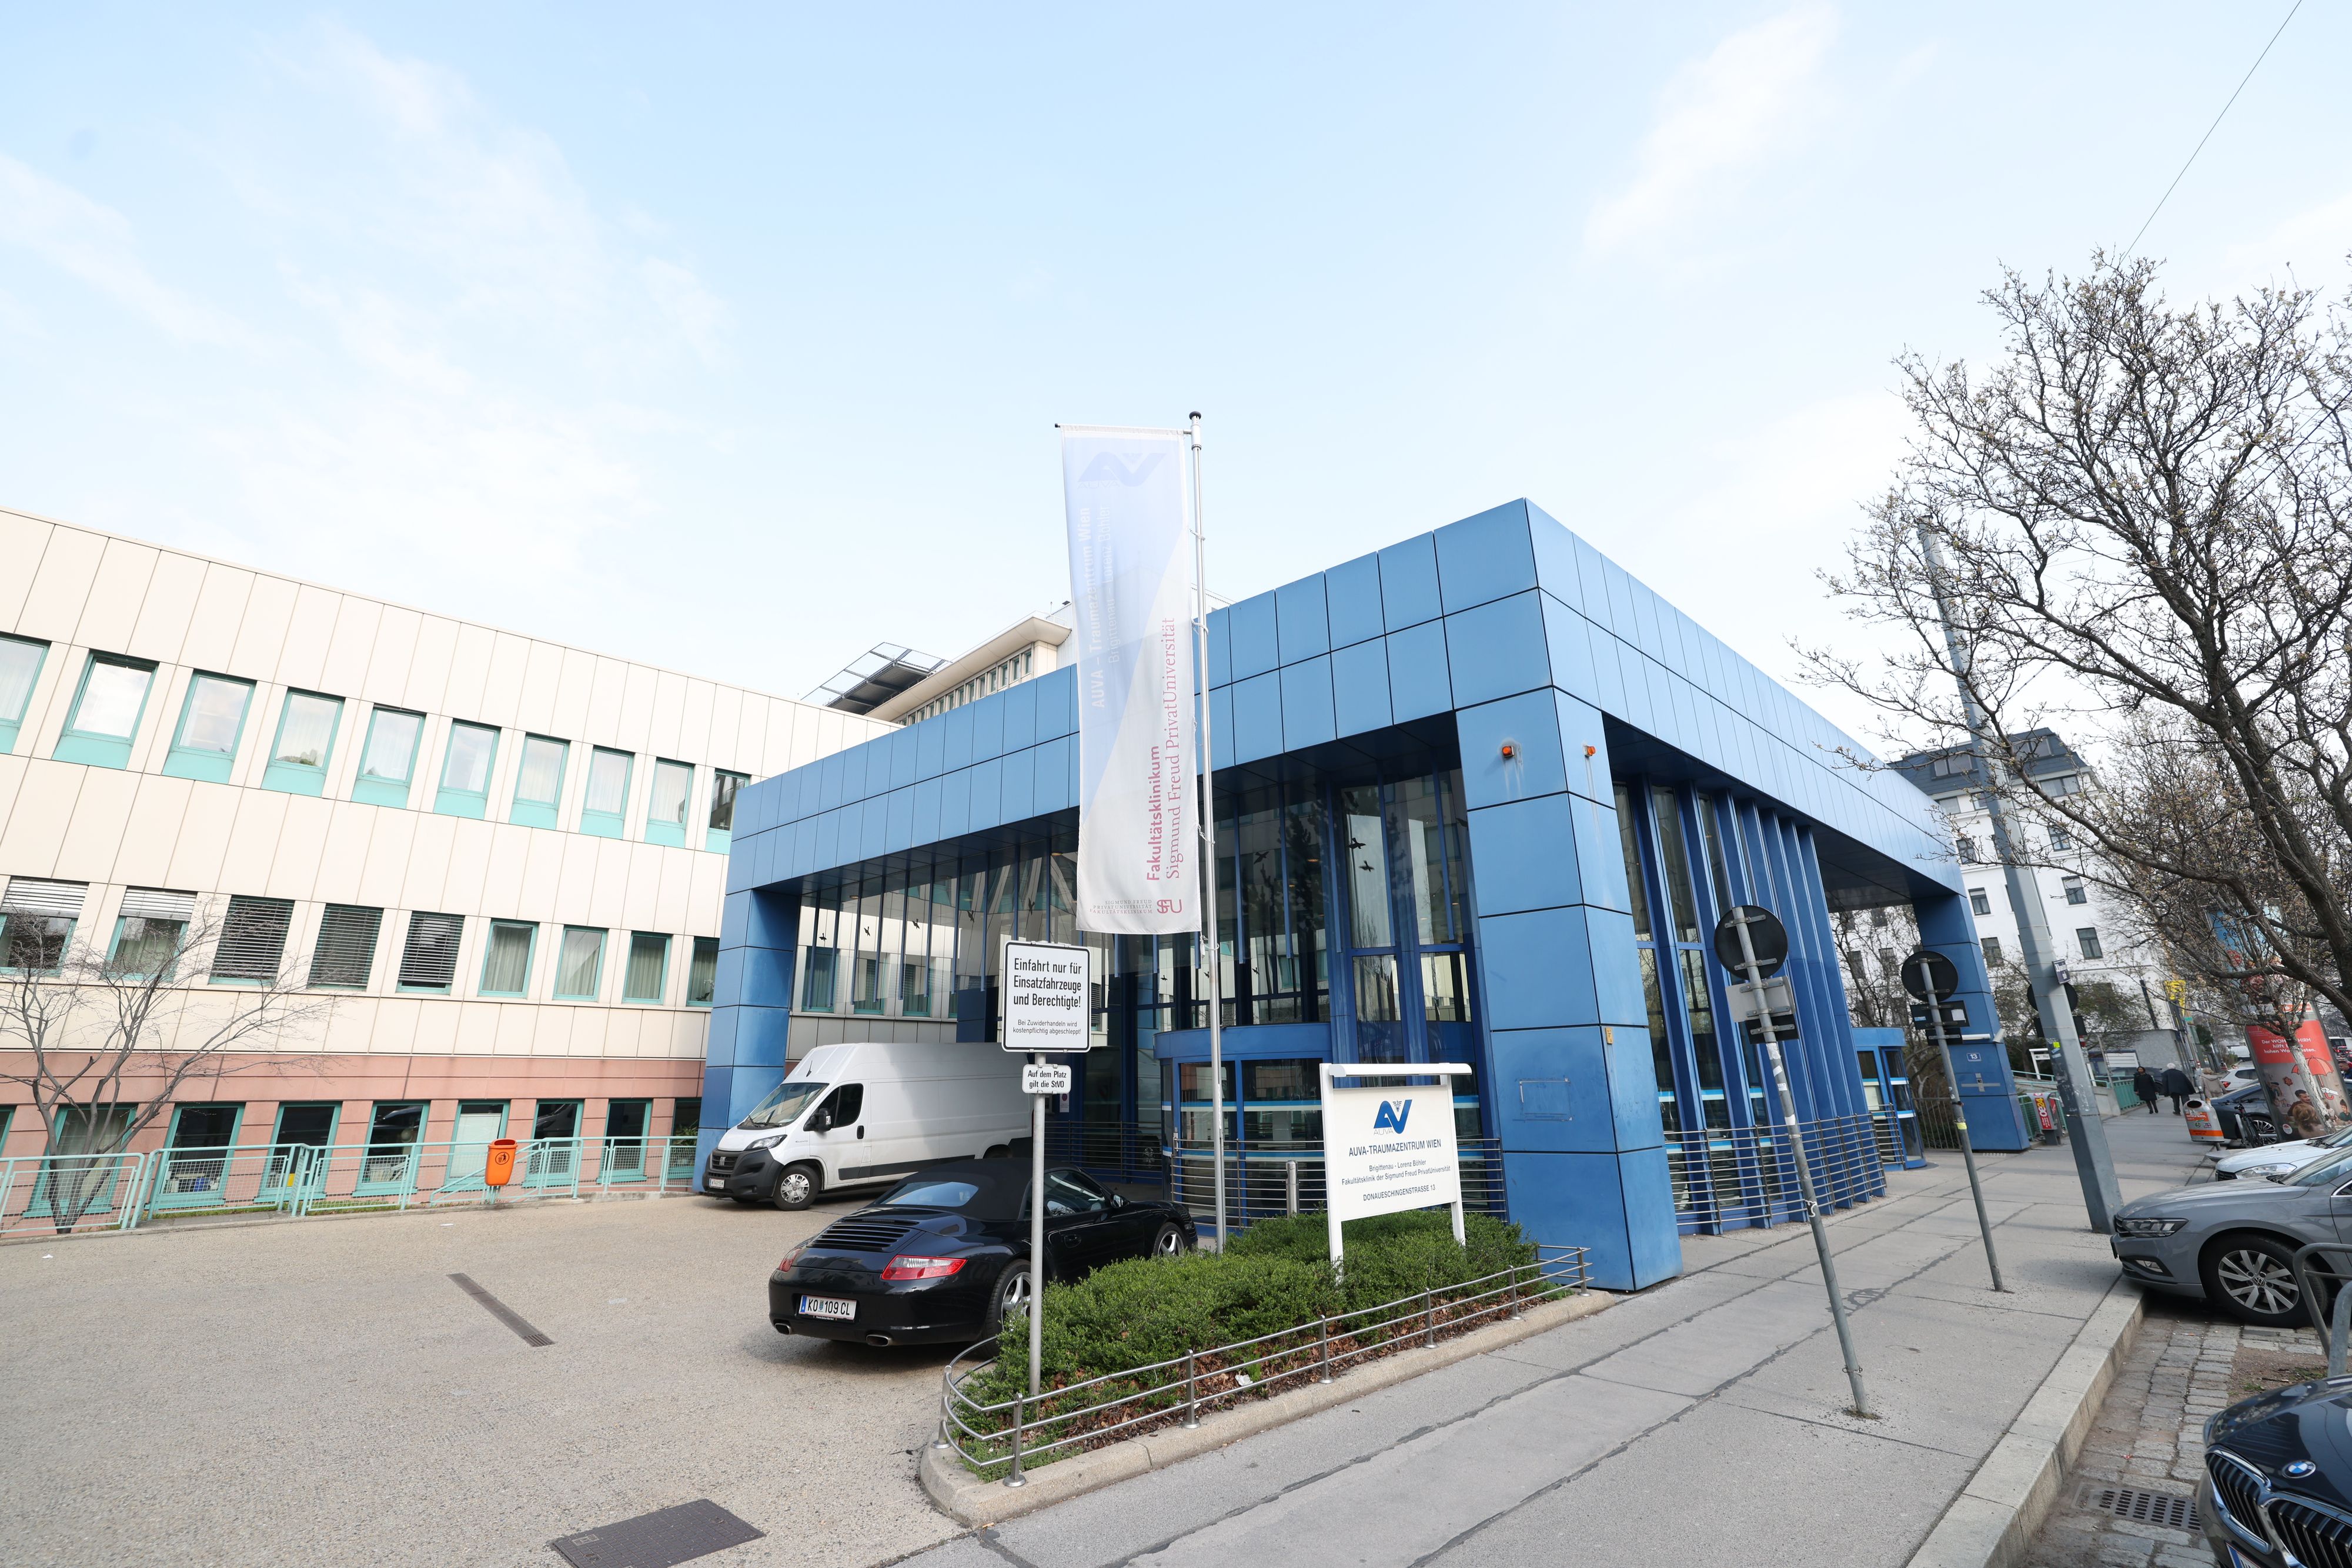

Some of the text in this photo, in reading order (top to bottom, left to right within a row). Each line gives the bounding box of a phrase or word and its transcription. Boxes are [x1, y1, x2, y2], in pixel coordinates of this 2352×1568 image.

[1077, 481, 1120, 489] AUVA
[1078, 507, 1091, 542] Wien
[1097, 506, 1111, 542] Böhler
[1102, 546, 1114, 583] Lorenz
[1084, 546, 1102, 653] Traumazentrum
[1107, 599, 1120, 663] Brigittenau
[1092, 669, 1105, 708] AUVA
[1161, 617, 1184, 879] Sigmund Freud PrivatUniversität
[1147, 745, 1162, 881] Fakultätsklinikum
[1014, 958, 1082, 975] Einfahrt nur für
[1014, 975, 1081, 994] Einsatzfahrzeuge
[1013, 993, 1081, 1010] und Berechtigte!
[1029, 1080, 1038, 1089] gilt
[1053, 1071, 1067, 1079] Platz
[1349, 1139, 1441, 1156] AUVA-TRAUMAZENTRUM WIEN
[1342, 1173, 1376, 1185] Fakultätsklinik
[1385, 1171, 1404, 1181] Sigmund
[1418, 1165, 1451, 1175] PrivatUniversität
[1369, 1163, 1394, 1172] Brigittenau
[1363, 1185, 1429, 1201] DONAUESCHINGENSTRASSE
[807, 1299, 818, 1312] KO
[824, 1300, 838, 1313] 109
[840, 1302, 850, 1316] CL
